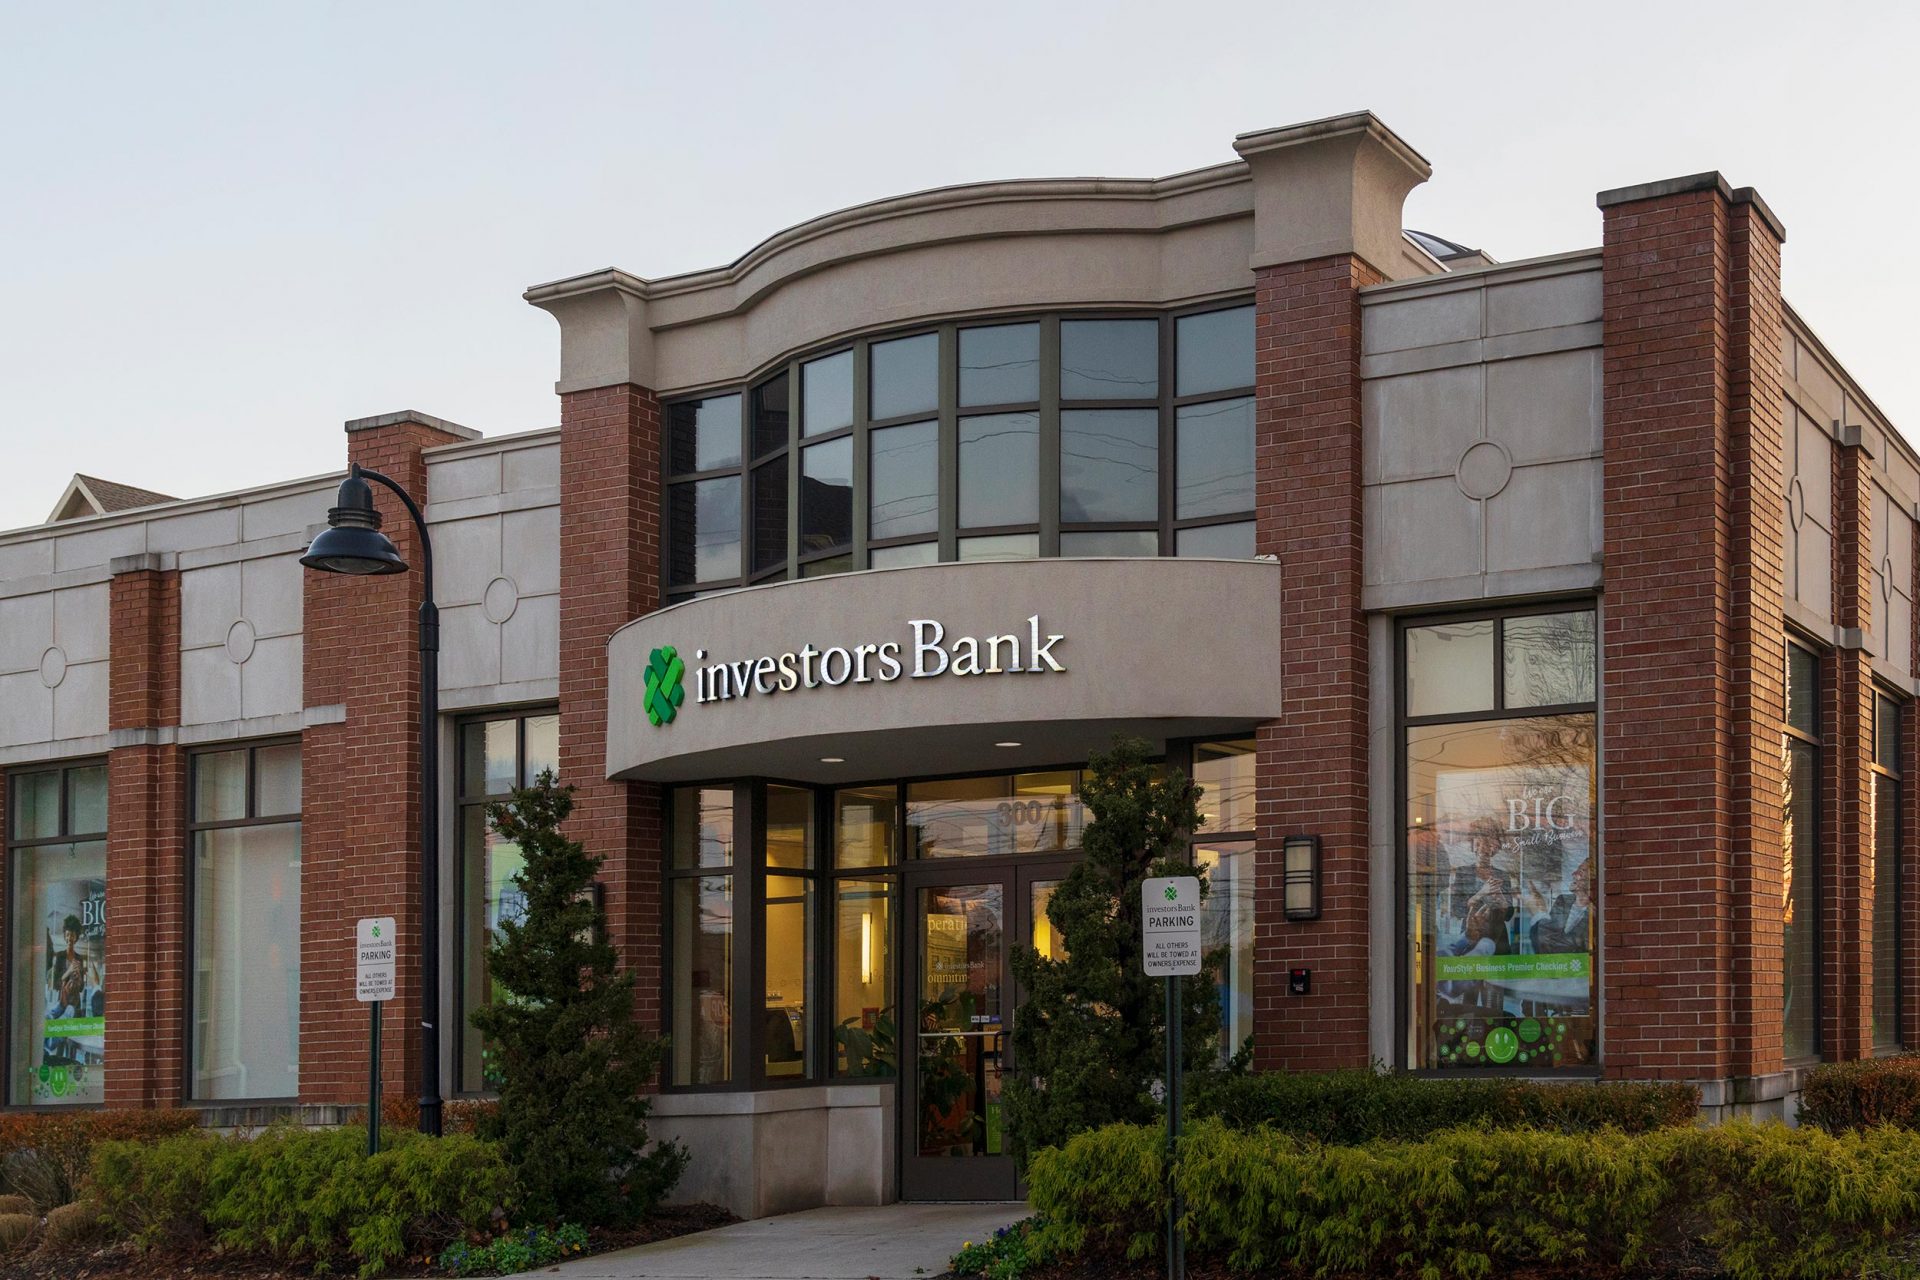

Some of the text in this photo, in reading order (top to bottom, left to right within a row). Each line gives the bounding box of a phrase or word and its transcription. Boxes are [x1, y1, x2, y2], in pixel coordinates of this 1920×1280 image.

[997, 800, 1042, 827] 300
[1506, 795, 1577, 832] BIG
[1146, 903, 1196, 913] investorsBank
[1149, 916, 1194, 927] PARKING
[361, 950, 392, 960] PARKING
[1475, 963, 1506, 972] Business
[1507, 962, 1534, 972] Premier
[1535, 961, 1568, 972] Checking
